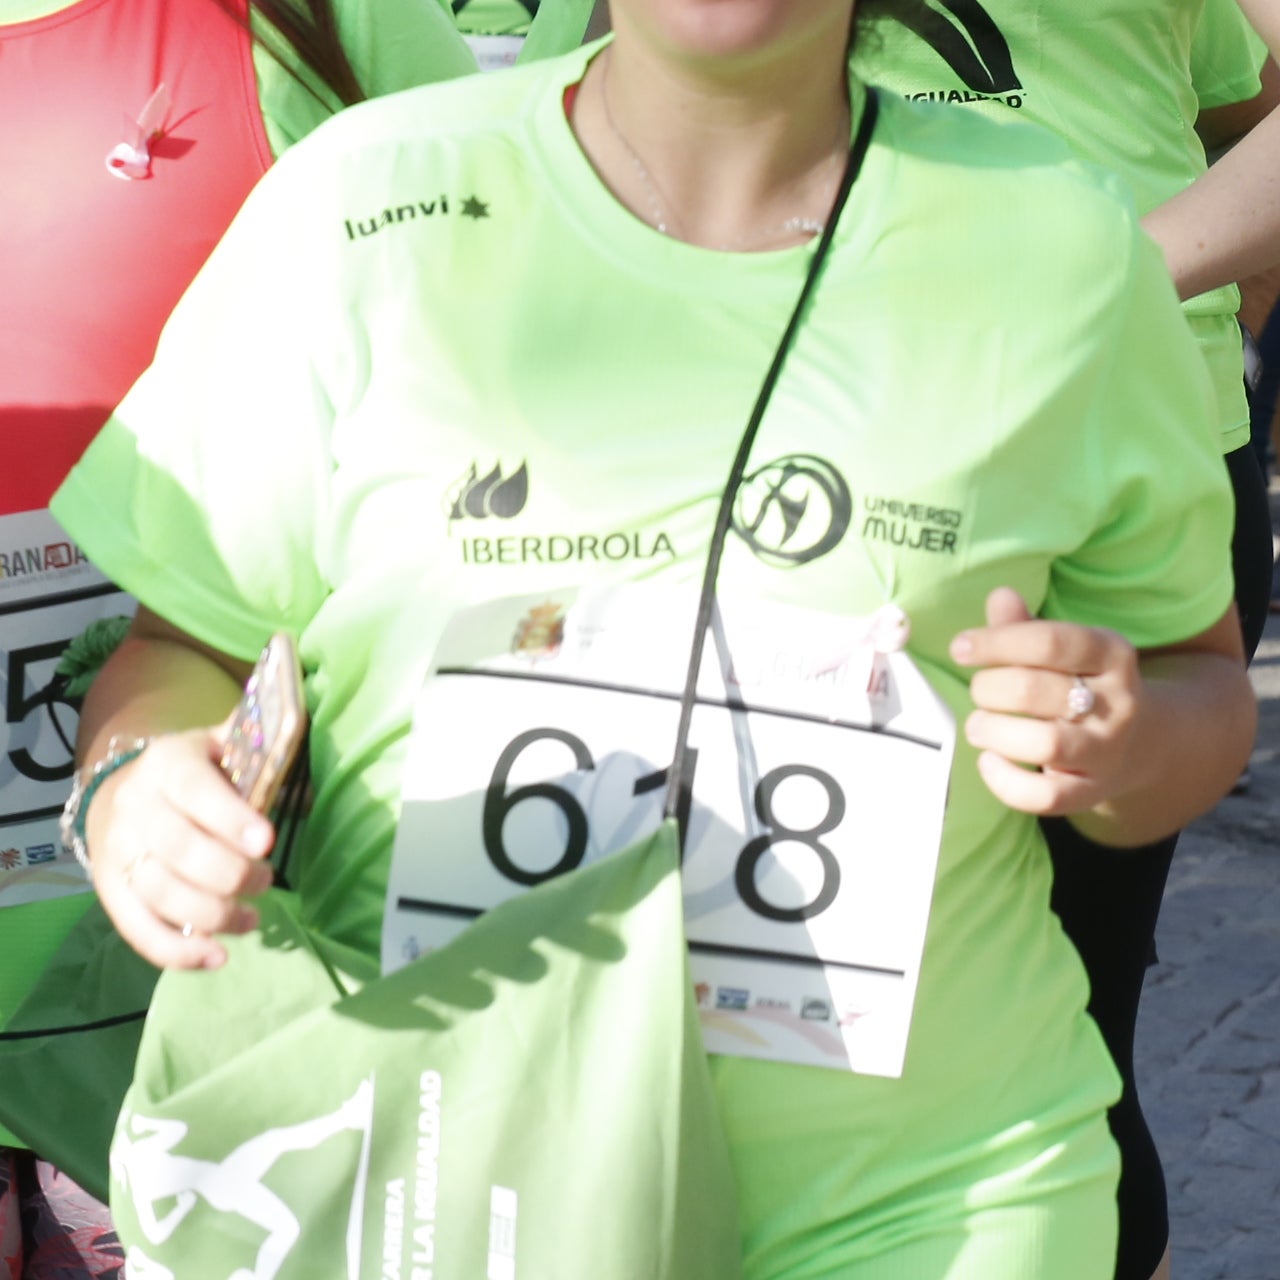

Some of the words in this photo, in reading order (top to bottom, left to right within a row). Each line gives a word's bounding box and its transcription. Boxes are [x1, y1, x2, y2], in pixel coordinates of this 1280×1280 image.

[345, 194, 449, 240] luanvi
[864, 496, 962, 529] UNIVERSO
[462, 533, 676, 564] IBERDROLA
[863, 516, 957, 555] MUJER
[482, 727, 846, 922] 618
[414, 1070, 441, 1220] IGUALDAD
[382, 1177, 406, 1280] ARRERA
[412, 1223, 435, 1264] LA
